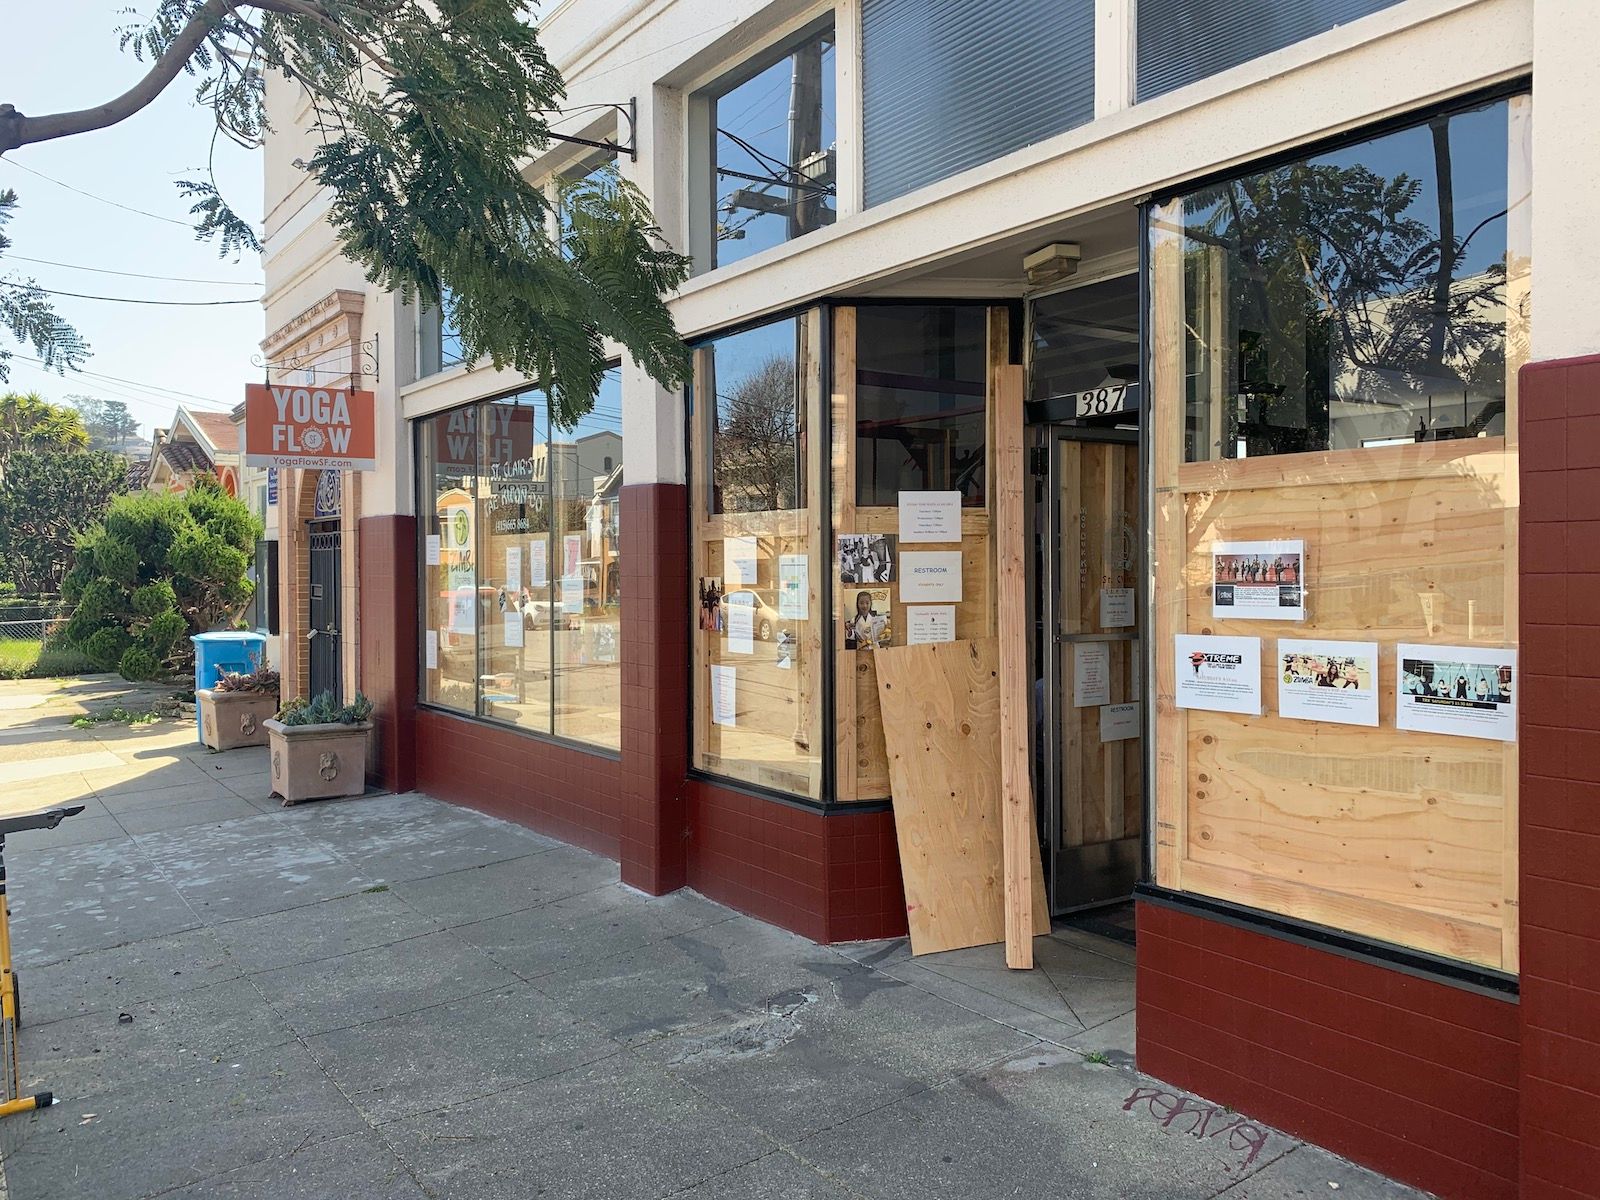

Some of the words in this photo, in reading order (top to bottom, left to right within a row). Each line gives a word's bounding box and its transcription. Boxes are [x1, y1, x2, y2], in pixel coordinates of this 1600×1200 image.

[271, 388, 351, 426] YOGA
[1078, 385, 1126, 417] 387
[272, 424, 352, 454] FLOW
[273, 456, 352, 467] YogaFlowSF.com
[1110, 705, 1134, 713] RESTROOM
